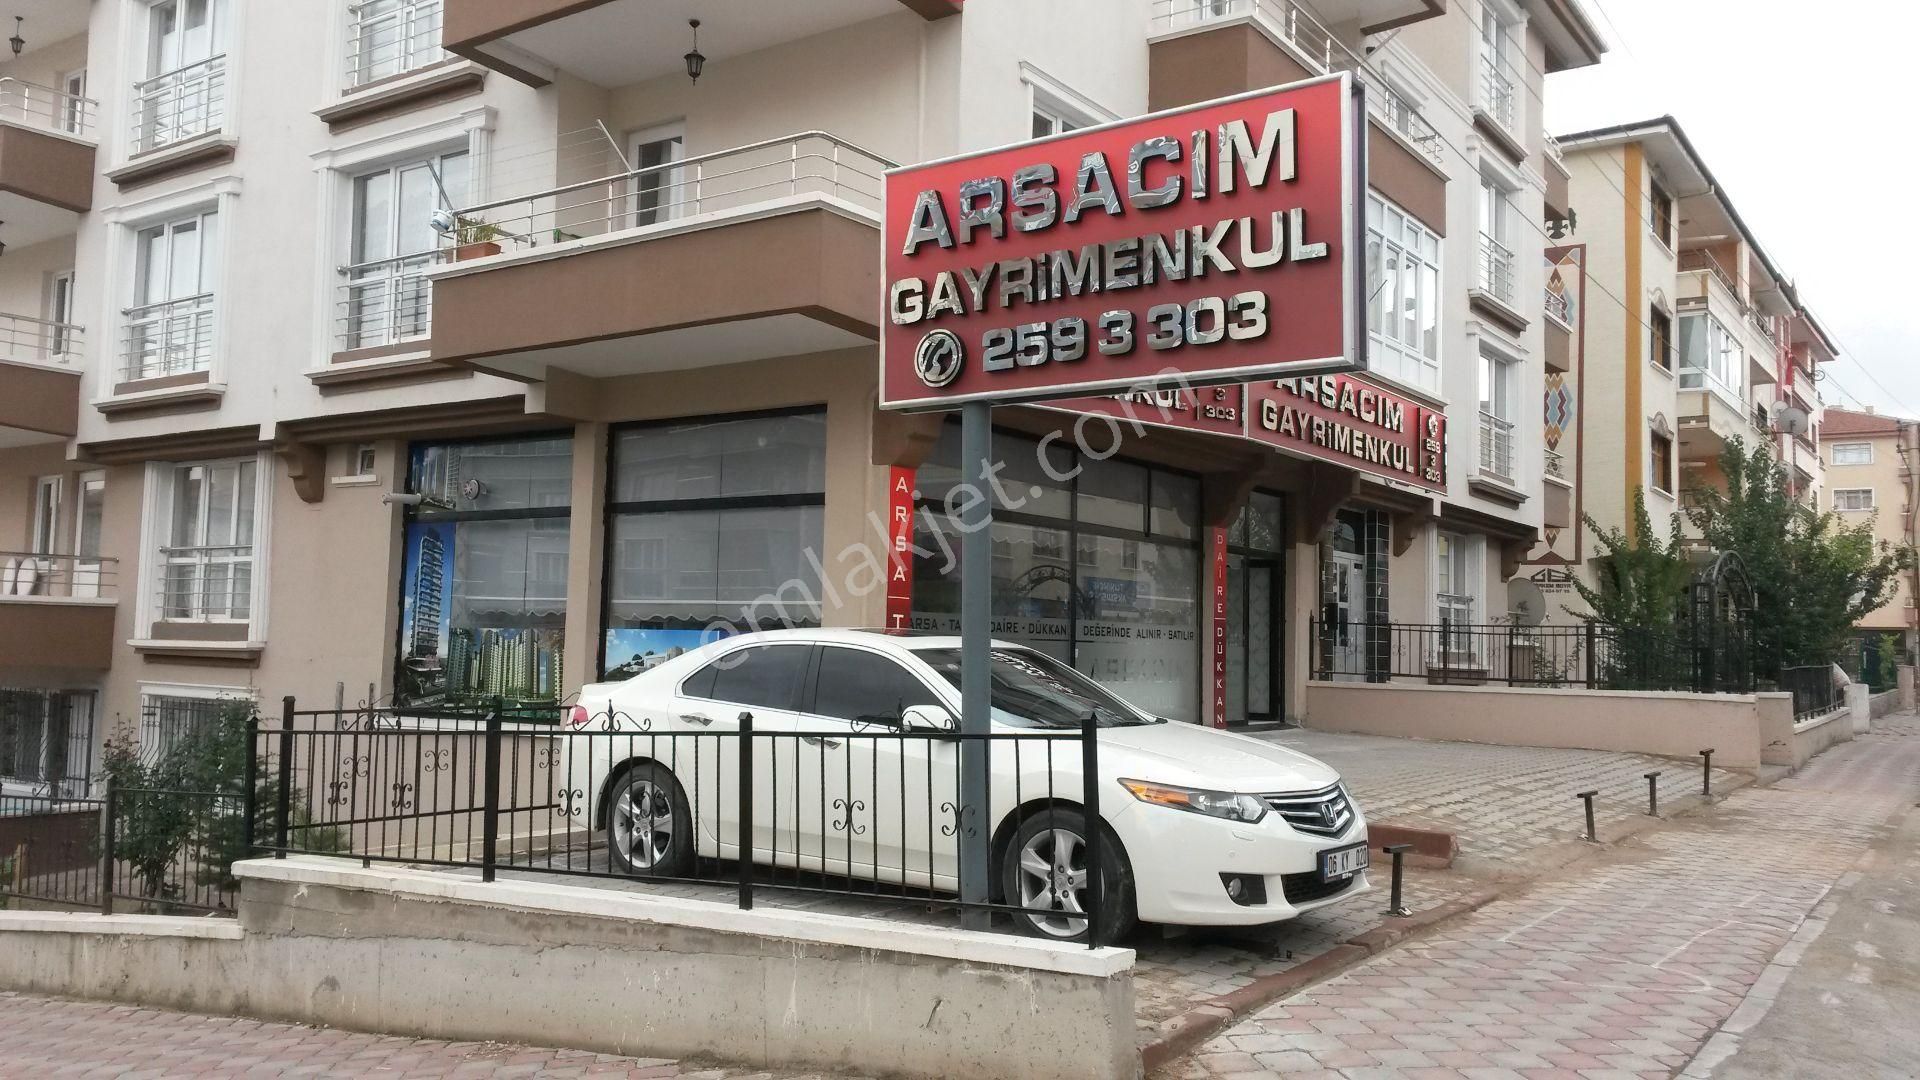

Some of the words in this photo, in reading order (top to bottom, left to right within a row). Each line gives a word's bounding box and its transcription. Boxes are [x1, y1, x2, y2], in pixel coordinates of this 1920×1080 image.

[902, 108, 1297, 256] ARSACIM
[982, 316, 1086, 373] 259
[1098, 309, 1135, 356] 3
[1146, 291, 1268, 351] 303
[1204, 404, 1236, 421] 303
[893, 476, 909, 582] ARSA
[1028, 619, 1067, 636] DÜKKAN
[1083, 623, 1131, 639] DEĞERİNDE
[1136, 629, 1162, 640] ALINIR
[1168, 630, 1194, 641] SATILIR
